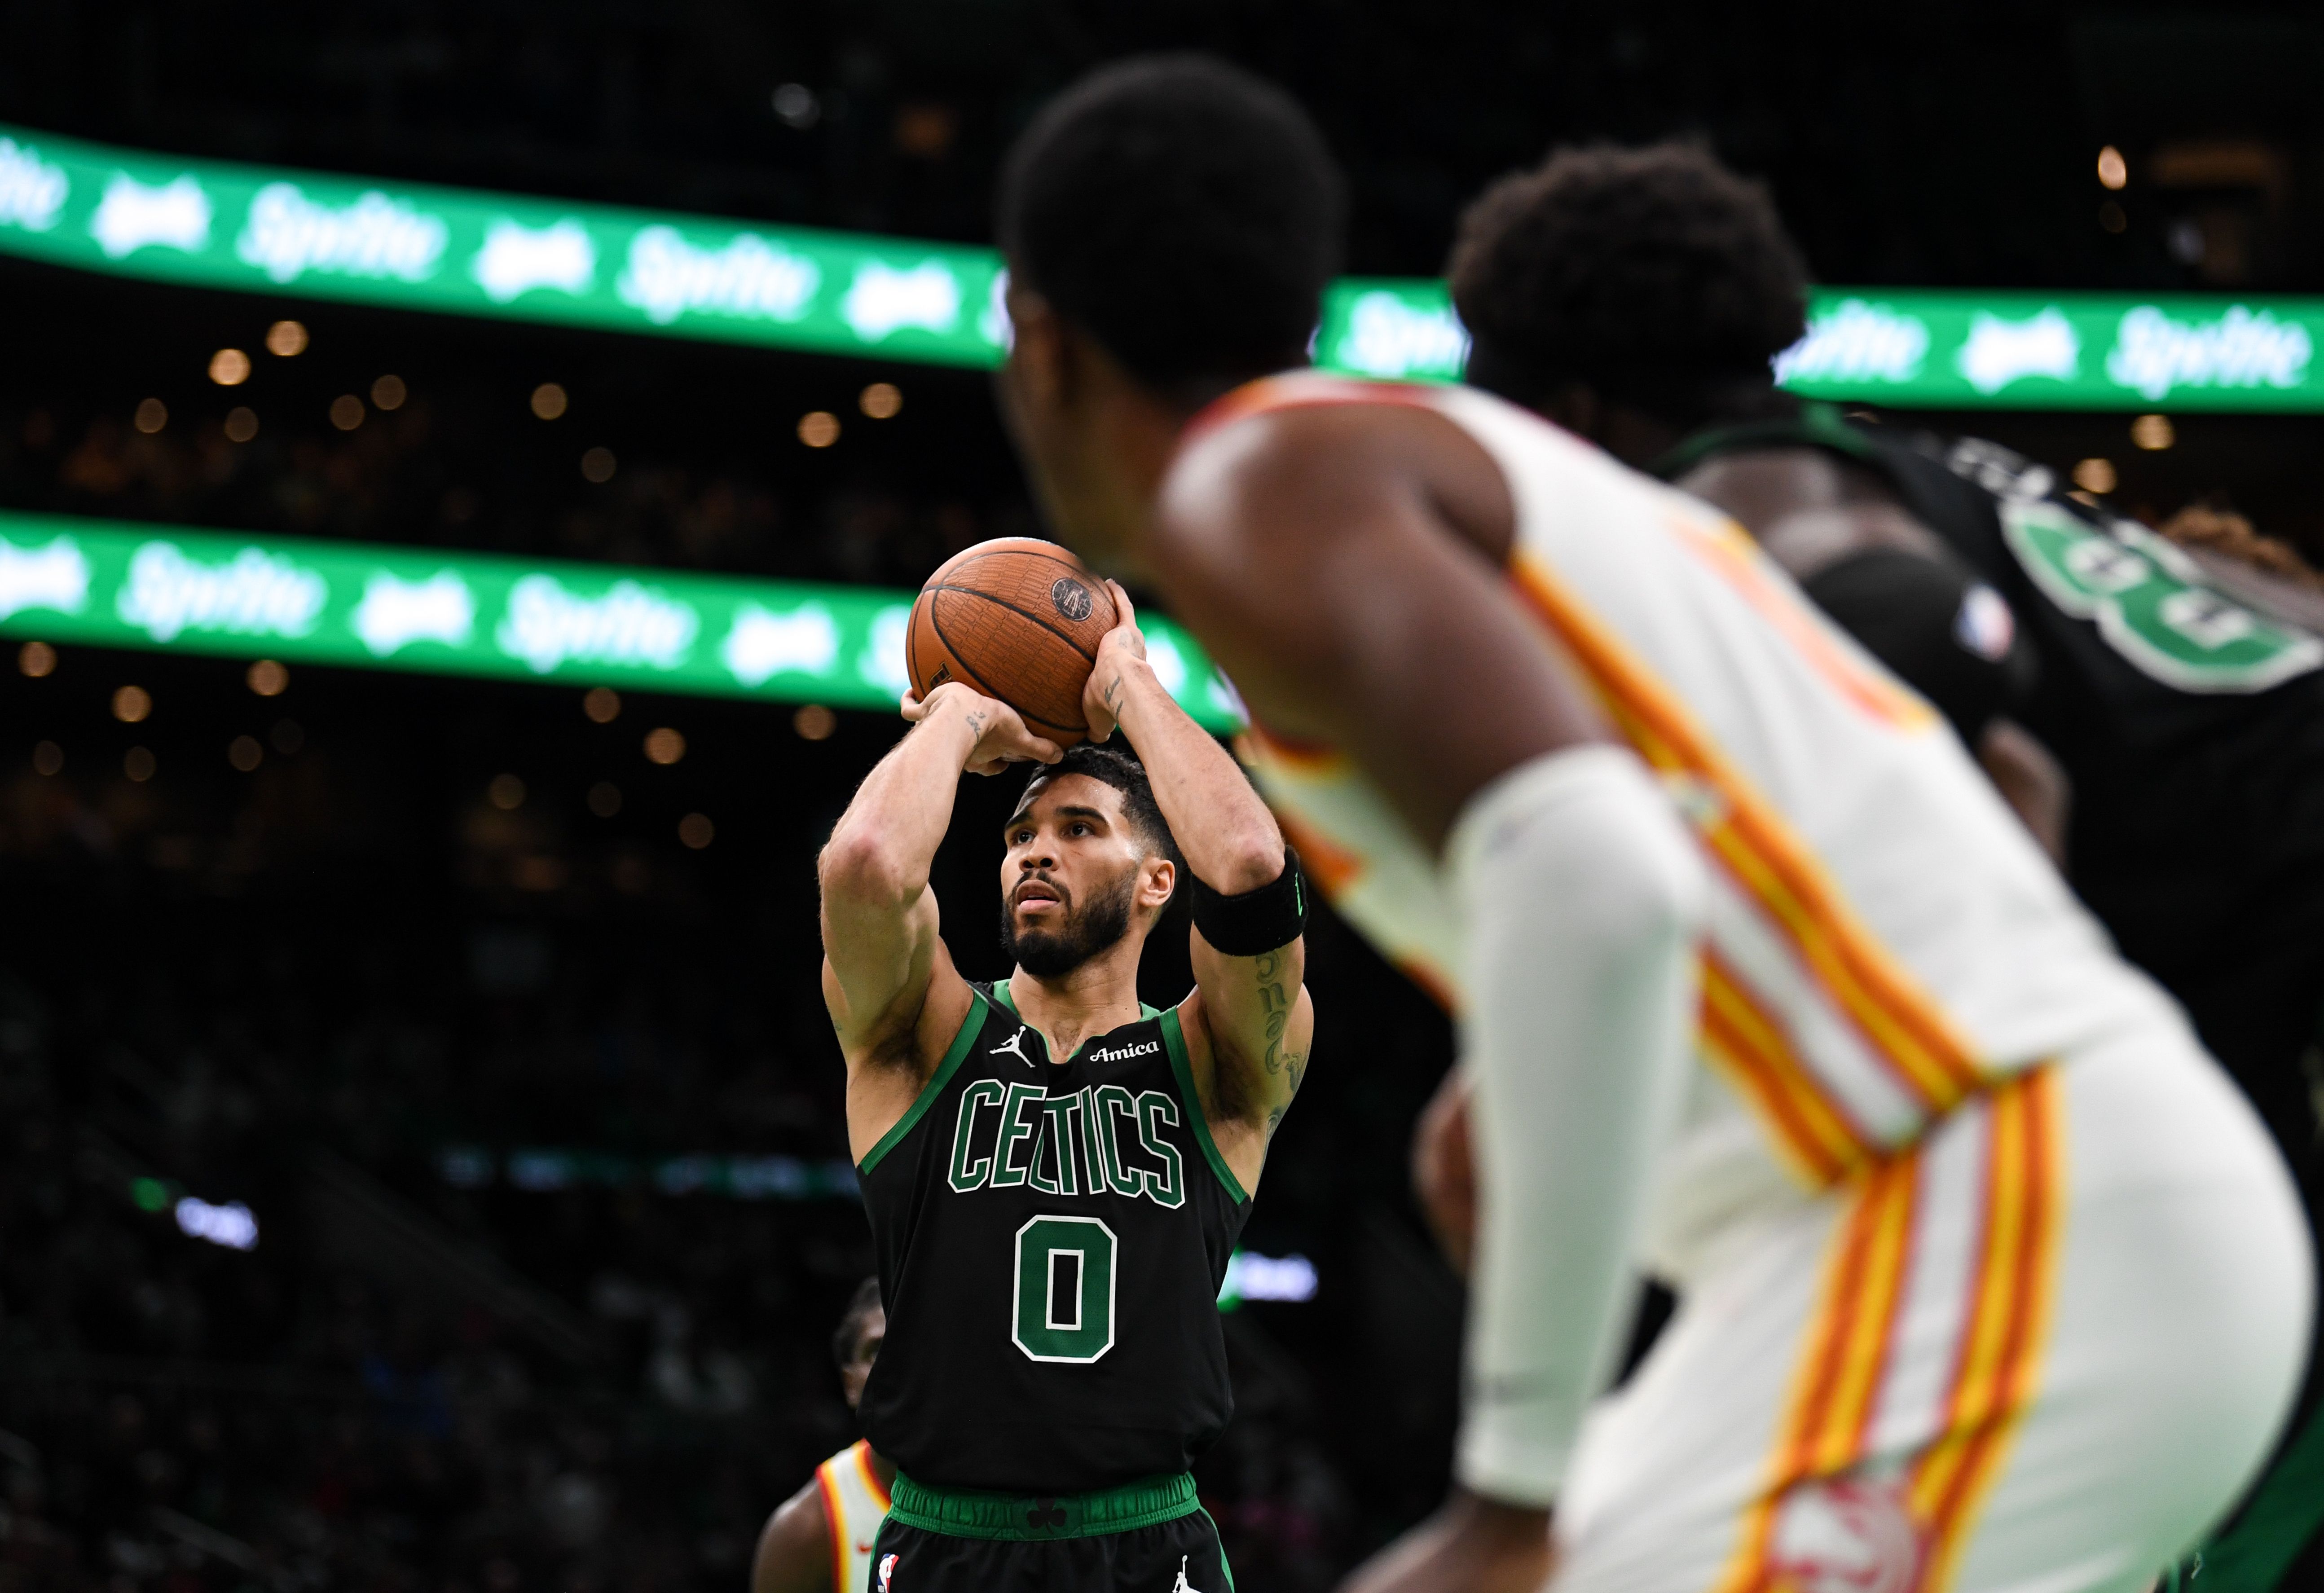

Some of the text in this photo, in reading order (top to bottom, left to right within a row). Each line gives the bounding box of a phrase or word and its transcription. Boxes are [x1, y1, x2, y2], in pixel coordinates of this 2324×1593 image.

[1089, 1041, 1160, 1062] Amica
[947, 1078, 1185, 1209] CELTICS
[1012, 1215, 1118, 1364] 0
